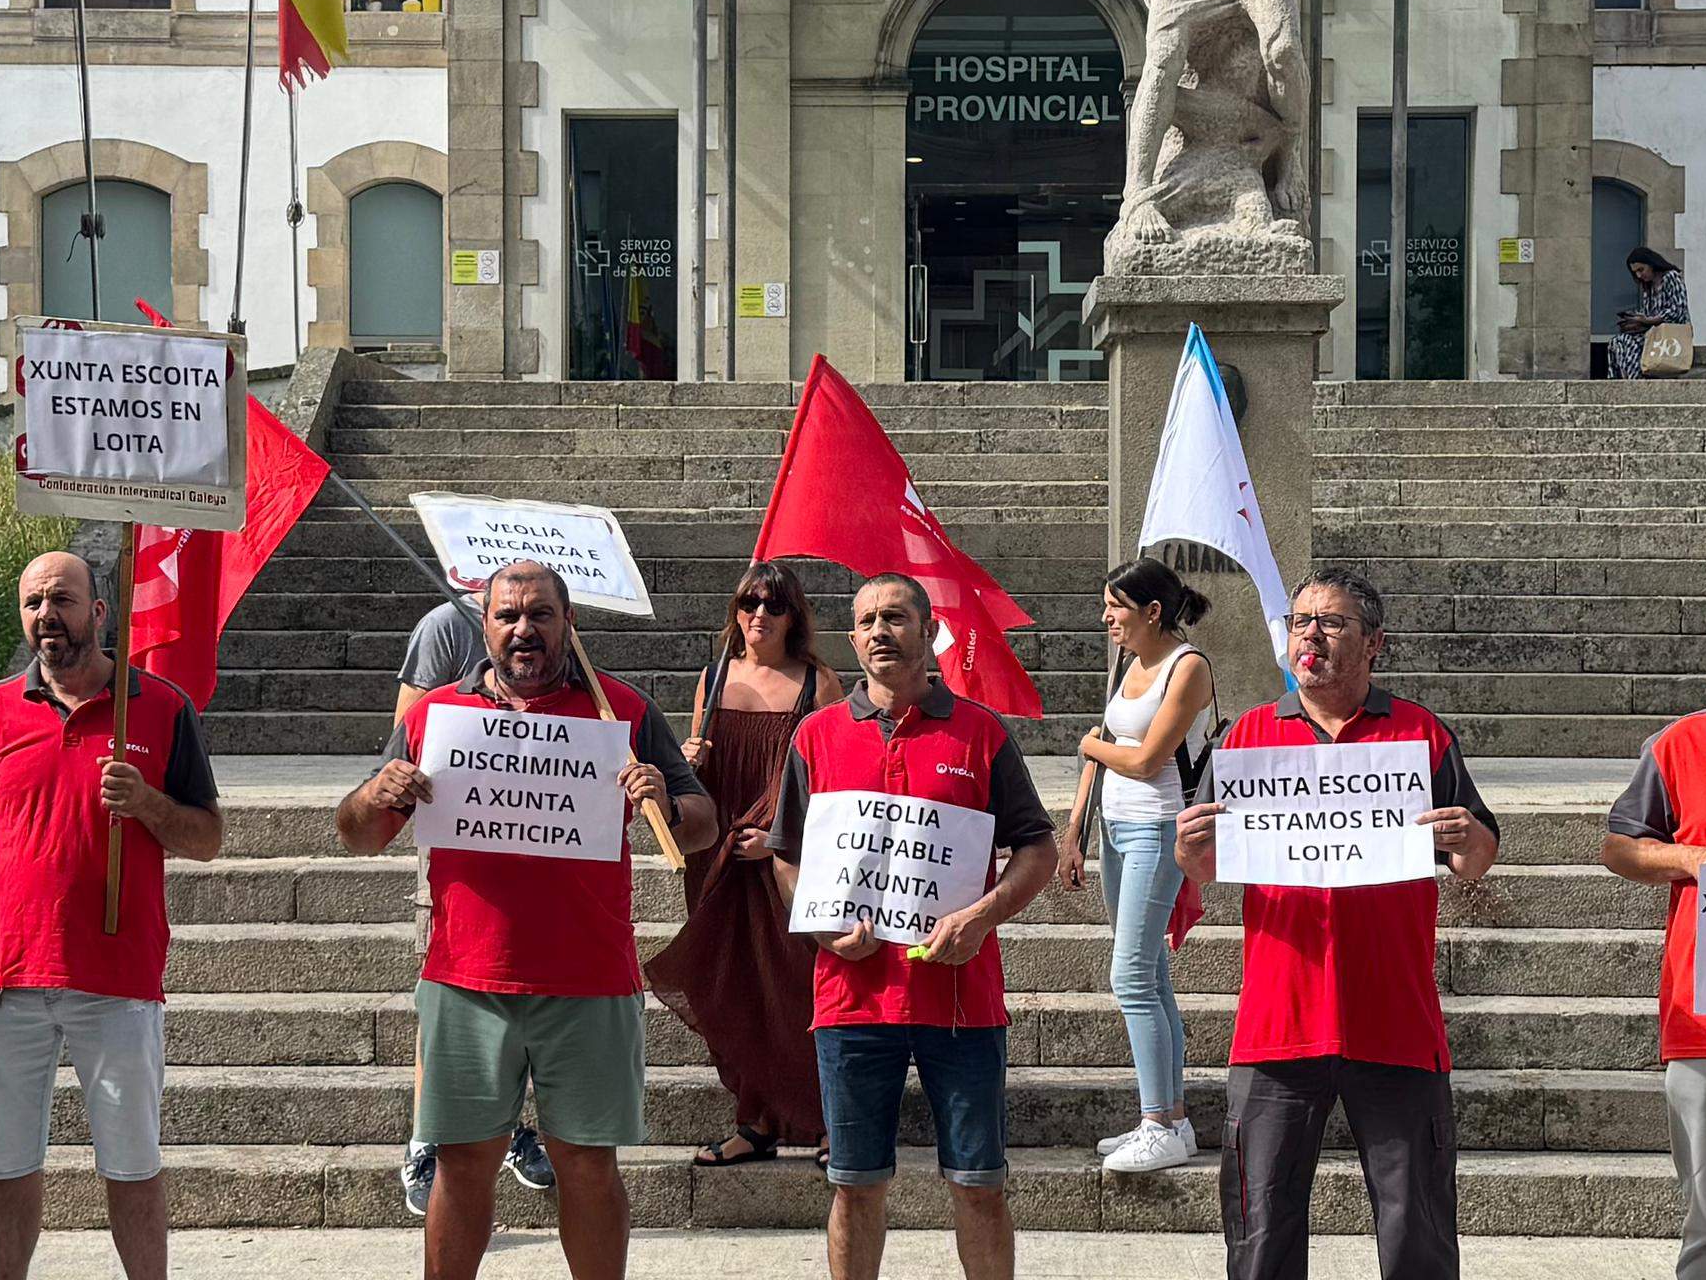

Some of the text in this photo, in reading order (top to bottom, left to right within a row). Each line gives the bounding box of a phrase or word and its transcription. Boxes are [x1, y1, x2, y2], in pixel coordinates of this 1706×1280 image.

[934, 56, 1100, 82] HOSPITAL
[914, 95, 1120, 121] PROVINCIAL
[619, 239, 671, 251] SERVIZO
[1405, 251, 1459, 263] GALEGO
[1406, 238, 1459, 250] SERVIZO
[619, 252, 671, 264] GALEGO
[630, 263, 672, 277] SAÚDE
[1416, 262, 1459, 277] SAÚDE
[29, 360, 220, 388] XUNTA ESCOITA
[51, 395, 201, 421] ESTAMOS EN
[93, 432, 164, 454] LOITA
[485, 521, 566, 539] VEOLIA
[466, 535, 601, 561] PRECARIZA E
[482, 717, 570, 744] VEOLIA
[449, 749, 598, 780] DISCRIMINA
[1221, 771, 1426, 801] XUNTA ESCOITA
[465, 786, 576, 813] A XUNTA
[857, 799, 941, 829] VEOLIA
[1244, 808, 1405, 832] ESTAMOS EN
[455, 818, 582, 846] PARTICIPA
[836, 832, 953, 866] CULPABLE
[1288, 844, 1363, 862] LOITA
[836, 867, 940, 901] A XUNTA
[805, 900, 939, 935] RESPONSAB
